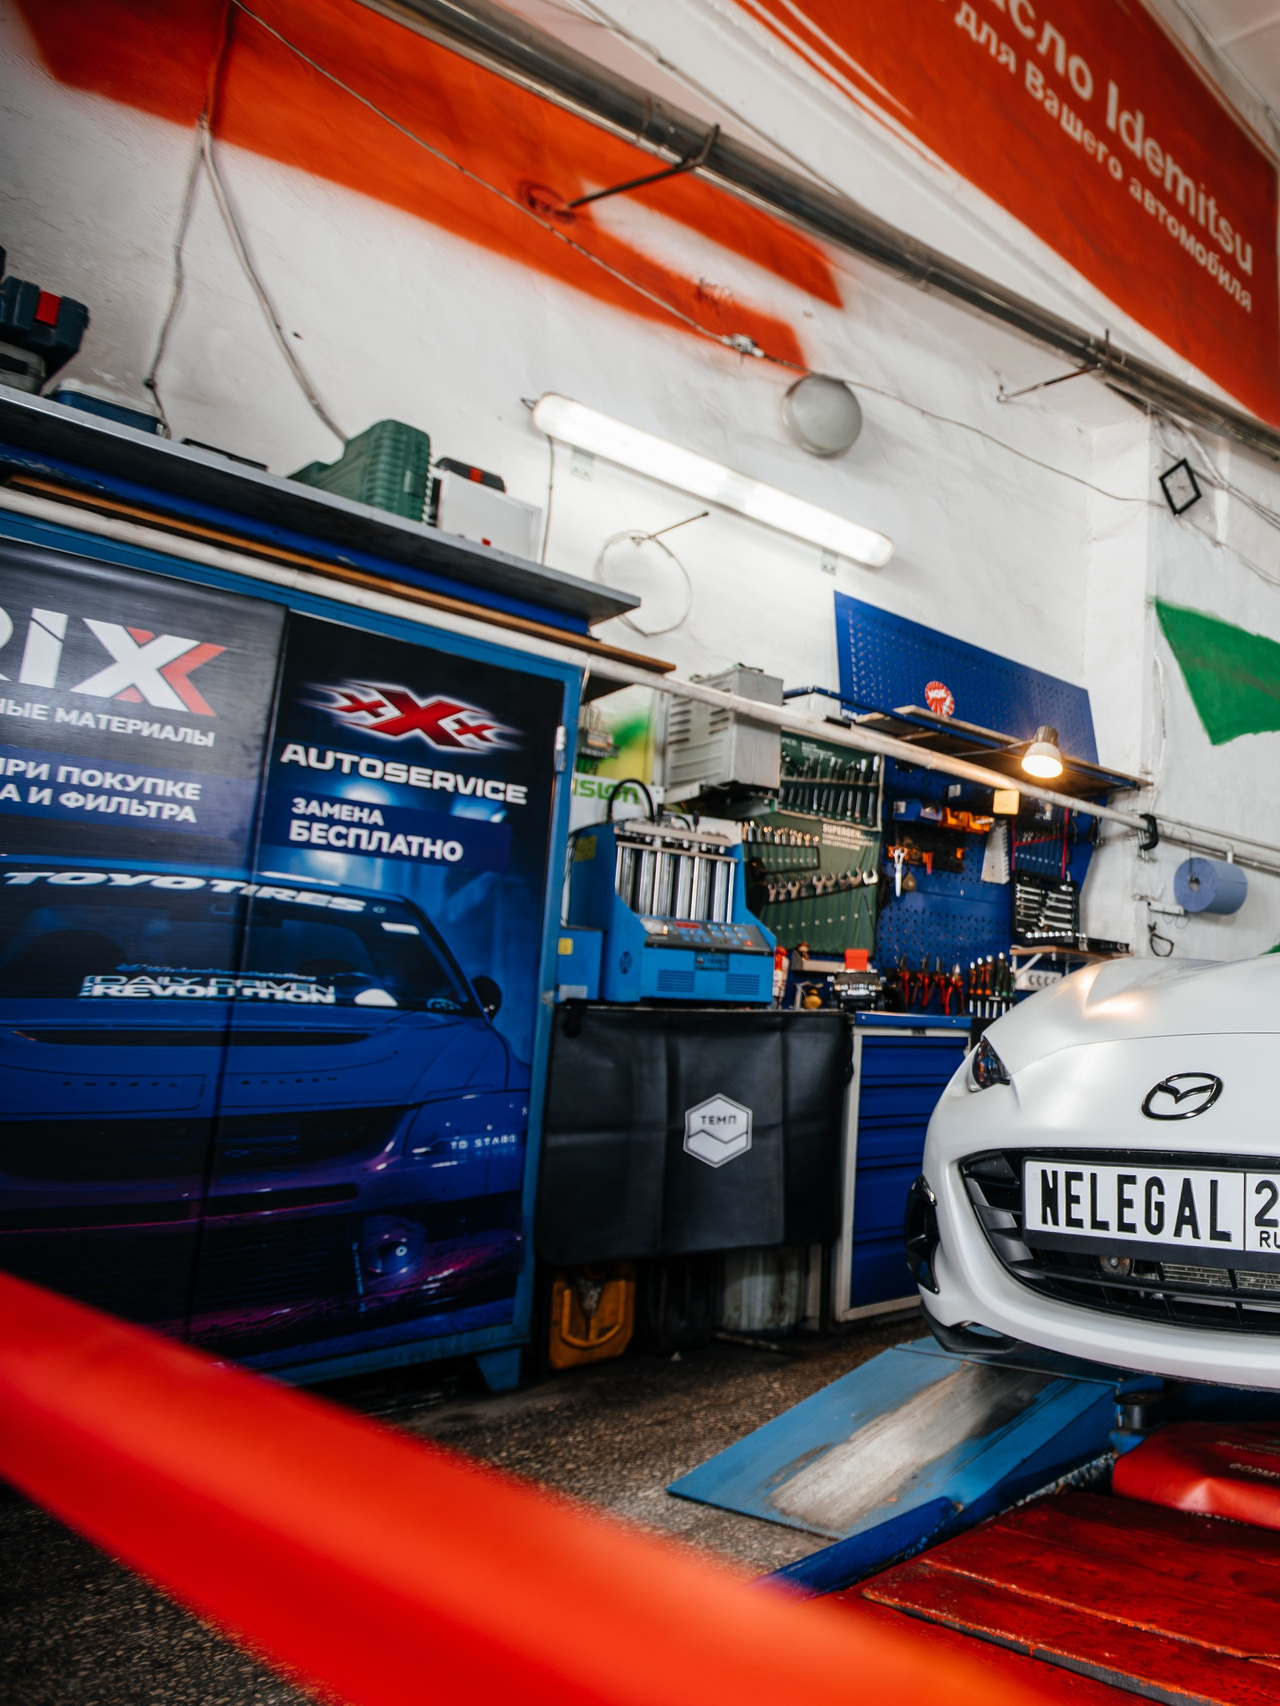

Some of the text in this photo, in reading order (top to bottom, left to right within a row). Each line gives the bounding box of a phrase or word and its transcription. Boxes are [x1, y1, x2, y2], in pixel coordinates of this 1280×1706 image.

[954, 1, 1252, 313] для Вашего автомобиля
[990, 0, 1253, 275] сло Idemitsu
[0, 606, 227, 717] IX
[54, 707, 216, 747] МАТЕРИАЛЫ
[0, 757, 203, 801] РИ ПОКУПКЕ
[280, 743, 528, 805] AUTOSERVICE
[28, 786, 53, 805] И
[58, 791, 197, 823] ФИЛЬТРА
[291, 797, 385, 826] ЗАМЕНА
[288, 819, 464, 862] БЕСПЛАТНО
[1040, 1168, 1233, 1243] NELEGAL
